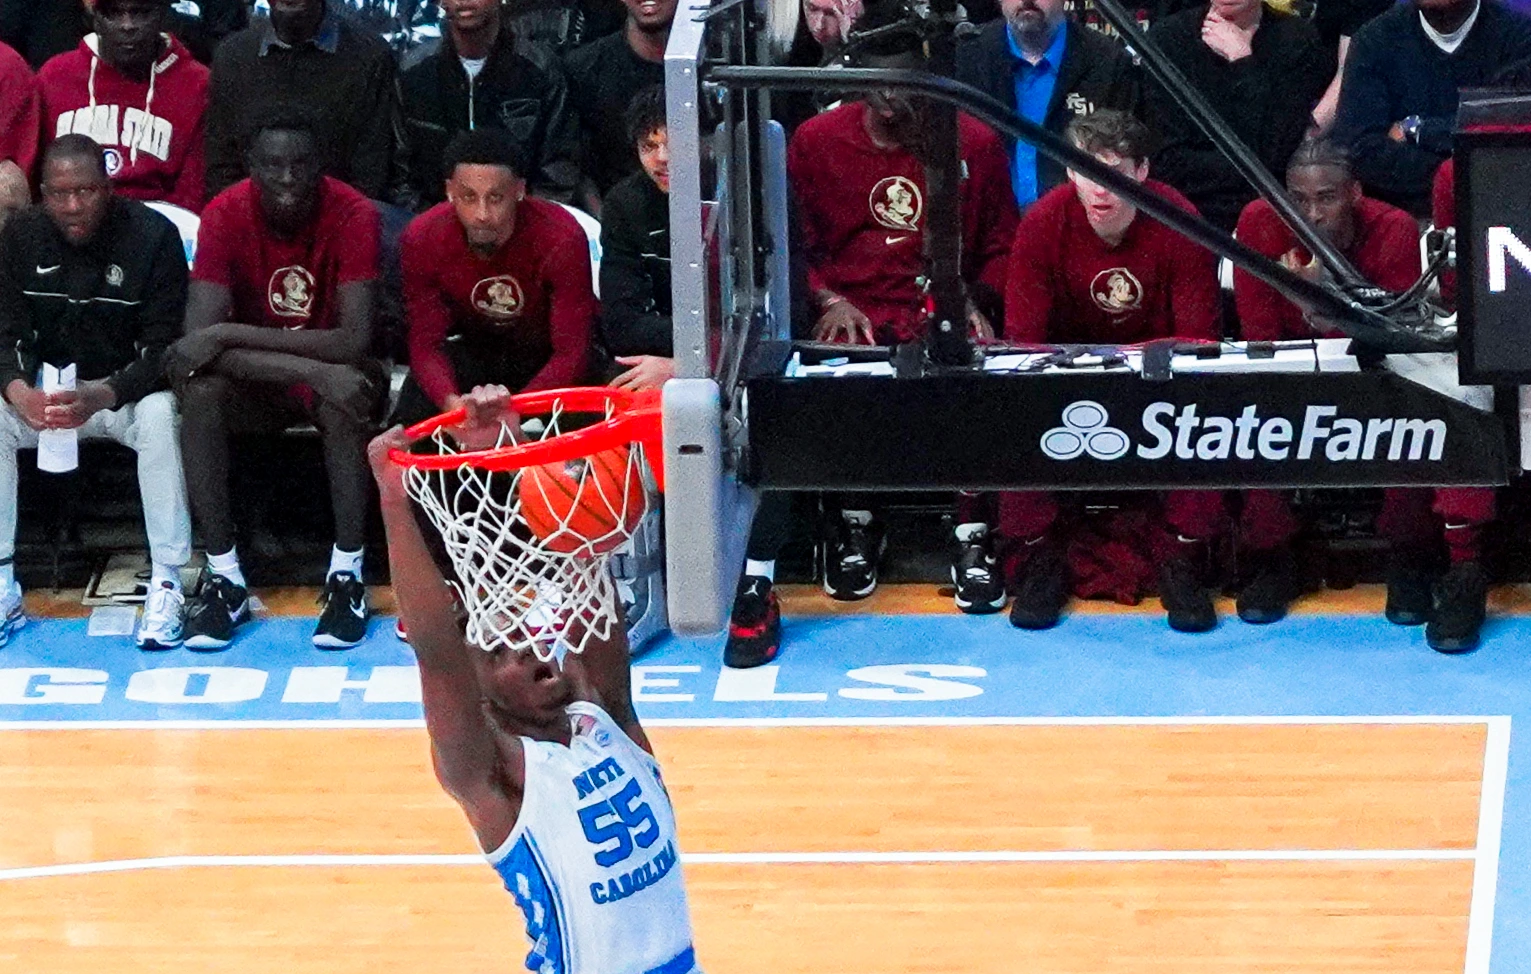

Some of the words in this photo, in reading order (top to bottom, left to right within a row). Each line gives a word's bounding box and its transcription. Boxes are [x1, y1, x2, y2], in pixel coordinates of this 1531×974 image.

[0, 666, 269, 704] GO
[281, 664, 987, 704] HELS
[577, 777, 660, 868] 55
